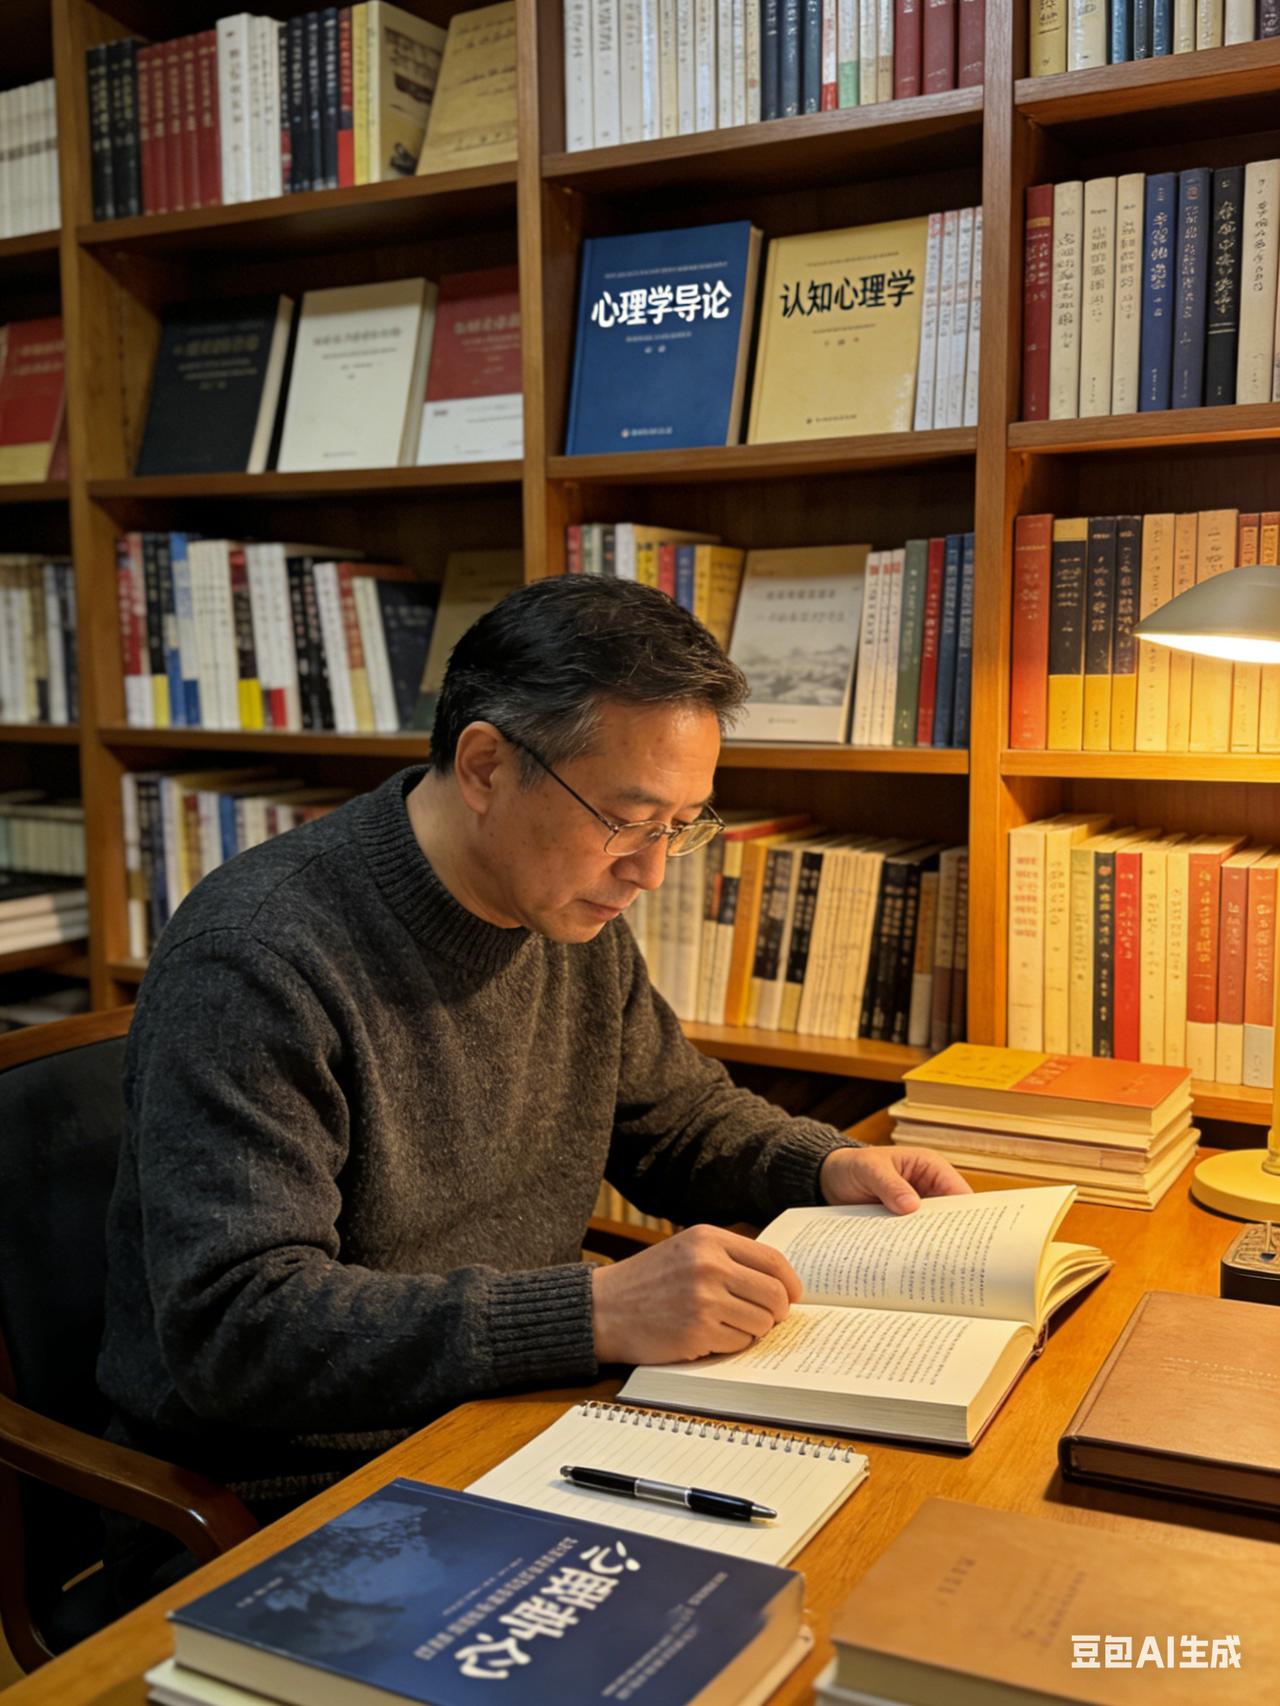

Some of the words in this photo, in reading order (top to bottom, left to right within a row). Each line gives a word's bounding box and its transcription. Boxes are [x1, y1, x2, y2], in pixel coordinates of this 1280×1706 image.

[591, 279, 732, 328] 心理学导论
[779, 268, 916, 318] 认知心理学
